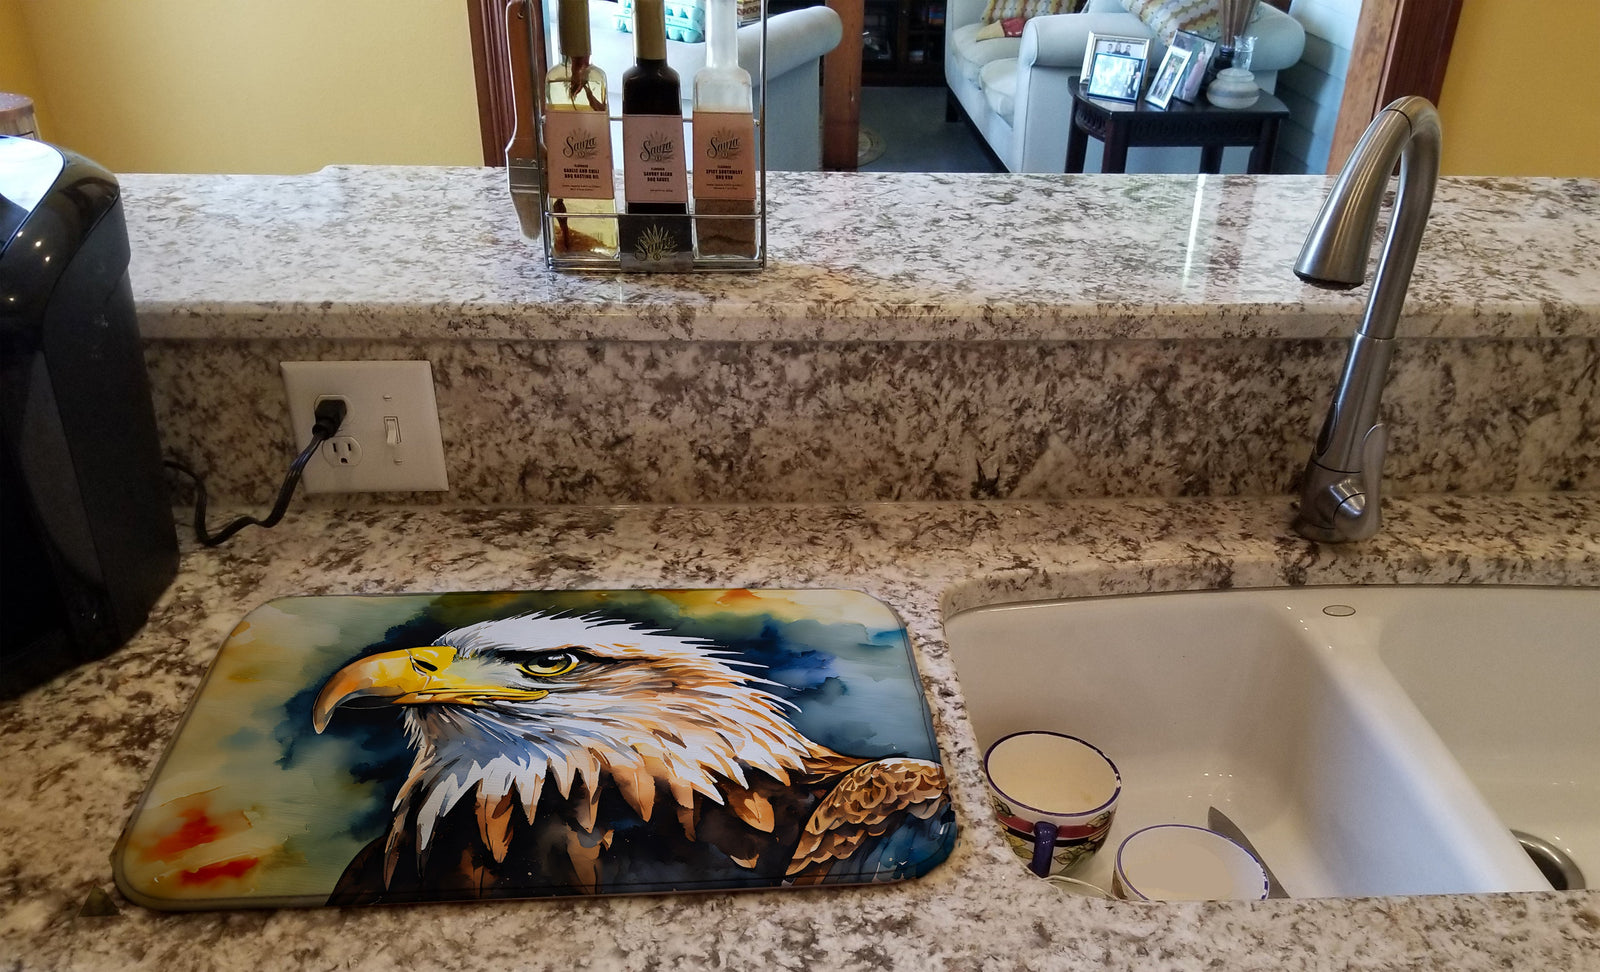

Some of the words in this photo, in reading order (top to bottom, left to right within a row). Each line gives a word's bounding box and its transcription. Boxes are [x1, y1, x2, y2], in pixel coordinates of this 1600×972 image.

[562, 136, 598, 158] Sauza
[640, 140, 673, 162] Sauza
[707, 137, 740, 159] Sauza
